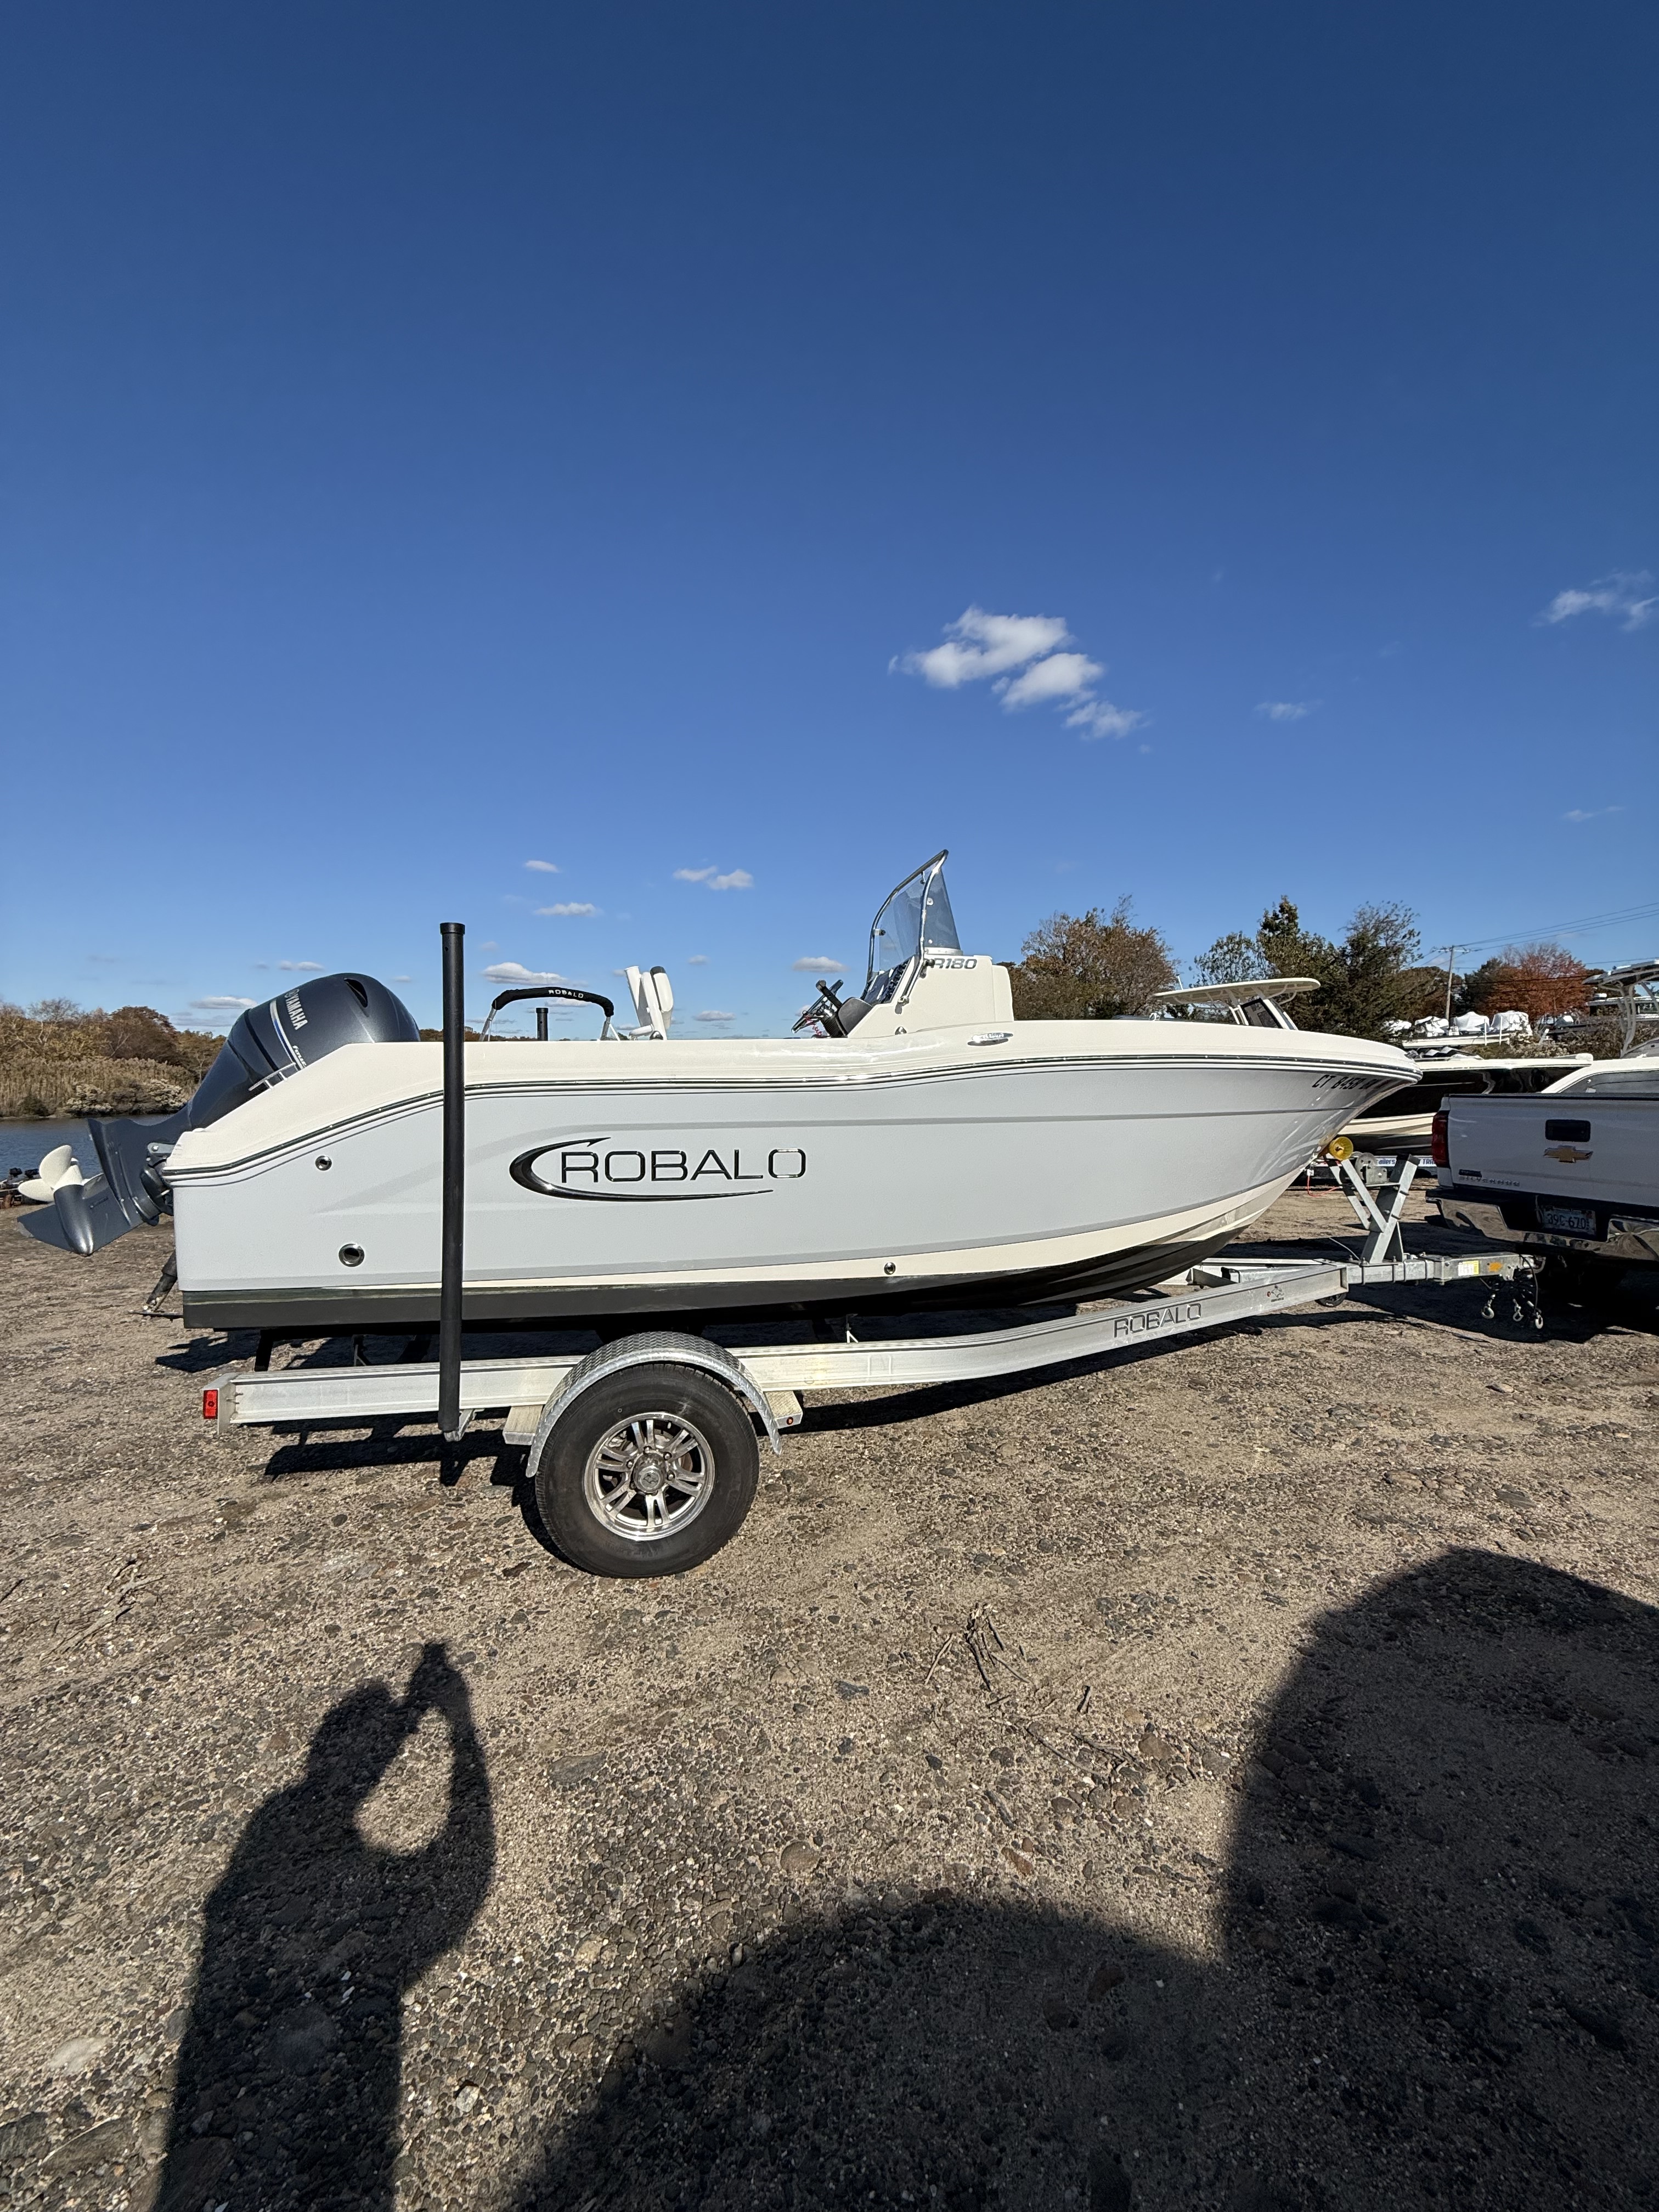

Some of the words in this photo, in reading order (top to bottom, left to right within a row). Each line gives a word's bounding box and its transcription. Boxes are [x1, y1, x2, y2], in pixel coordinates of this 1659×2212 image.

[930, 958, 977, 969] R180
[548, 990, 584, 998] ROBALO
[285, 994, 308, 1030] YAMAHA
[1312, 1074, 1336, 1088] CT
[561, 1148, 806, 1183] ROBALO
[1114, 1303, 1201, 1338] ROBALO
